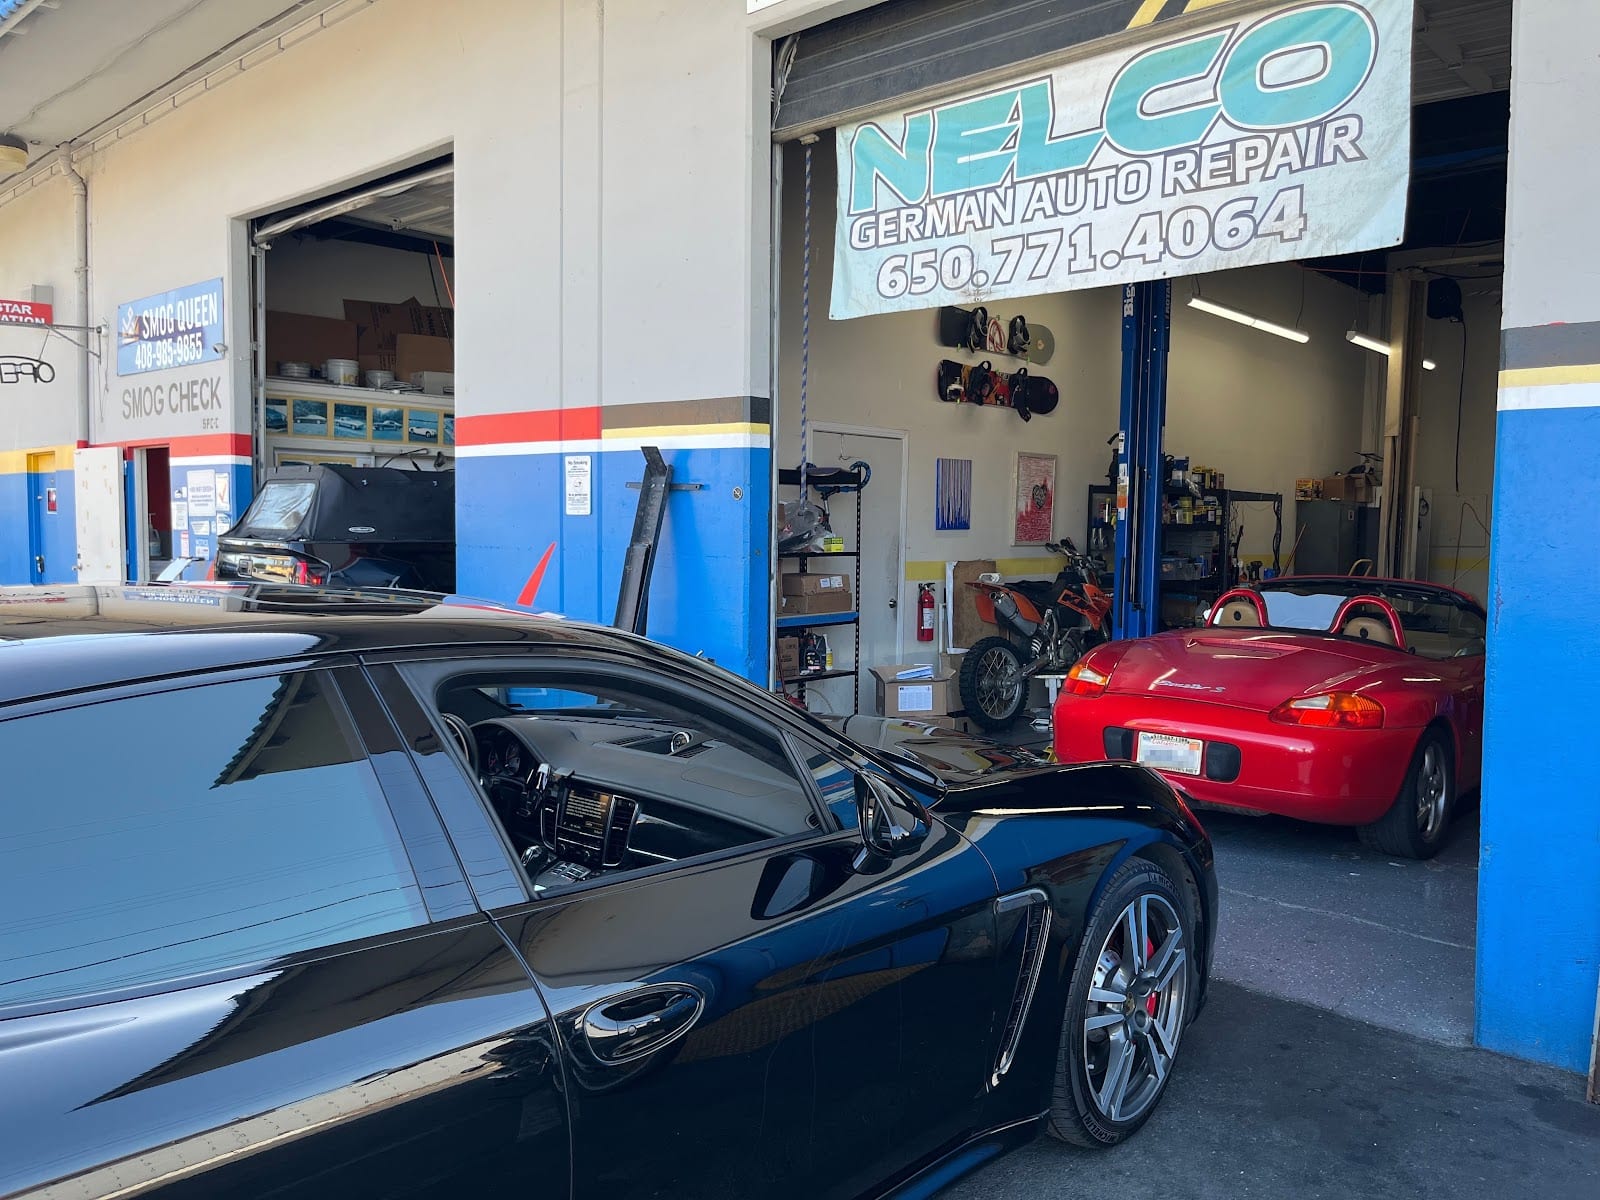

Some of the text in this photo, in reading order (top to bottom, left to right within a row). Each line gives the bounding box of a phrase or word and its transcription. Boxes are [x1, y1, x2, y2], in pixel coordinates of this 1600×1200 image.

[849, 1, 1379, 216] NELCO
[849, 112, 1367, 251] GERMAN AUTO REPAIR
[875, 184, 1308, 299] 650.771.4064
[0, 313, 46, 325] ATION
[142, 292, 217, 340] SMOG QUEEN
[135, 332, 203, 370] 408-985-9855
[122, 376, 222, 421] SMOG CHECK
